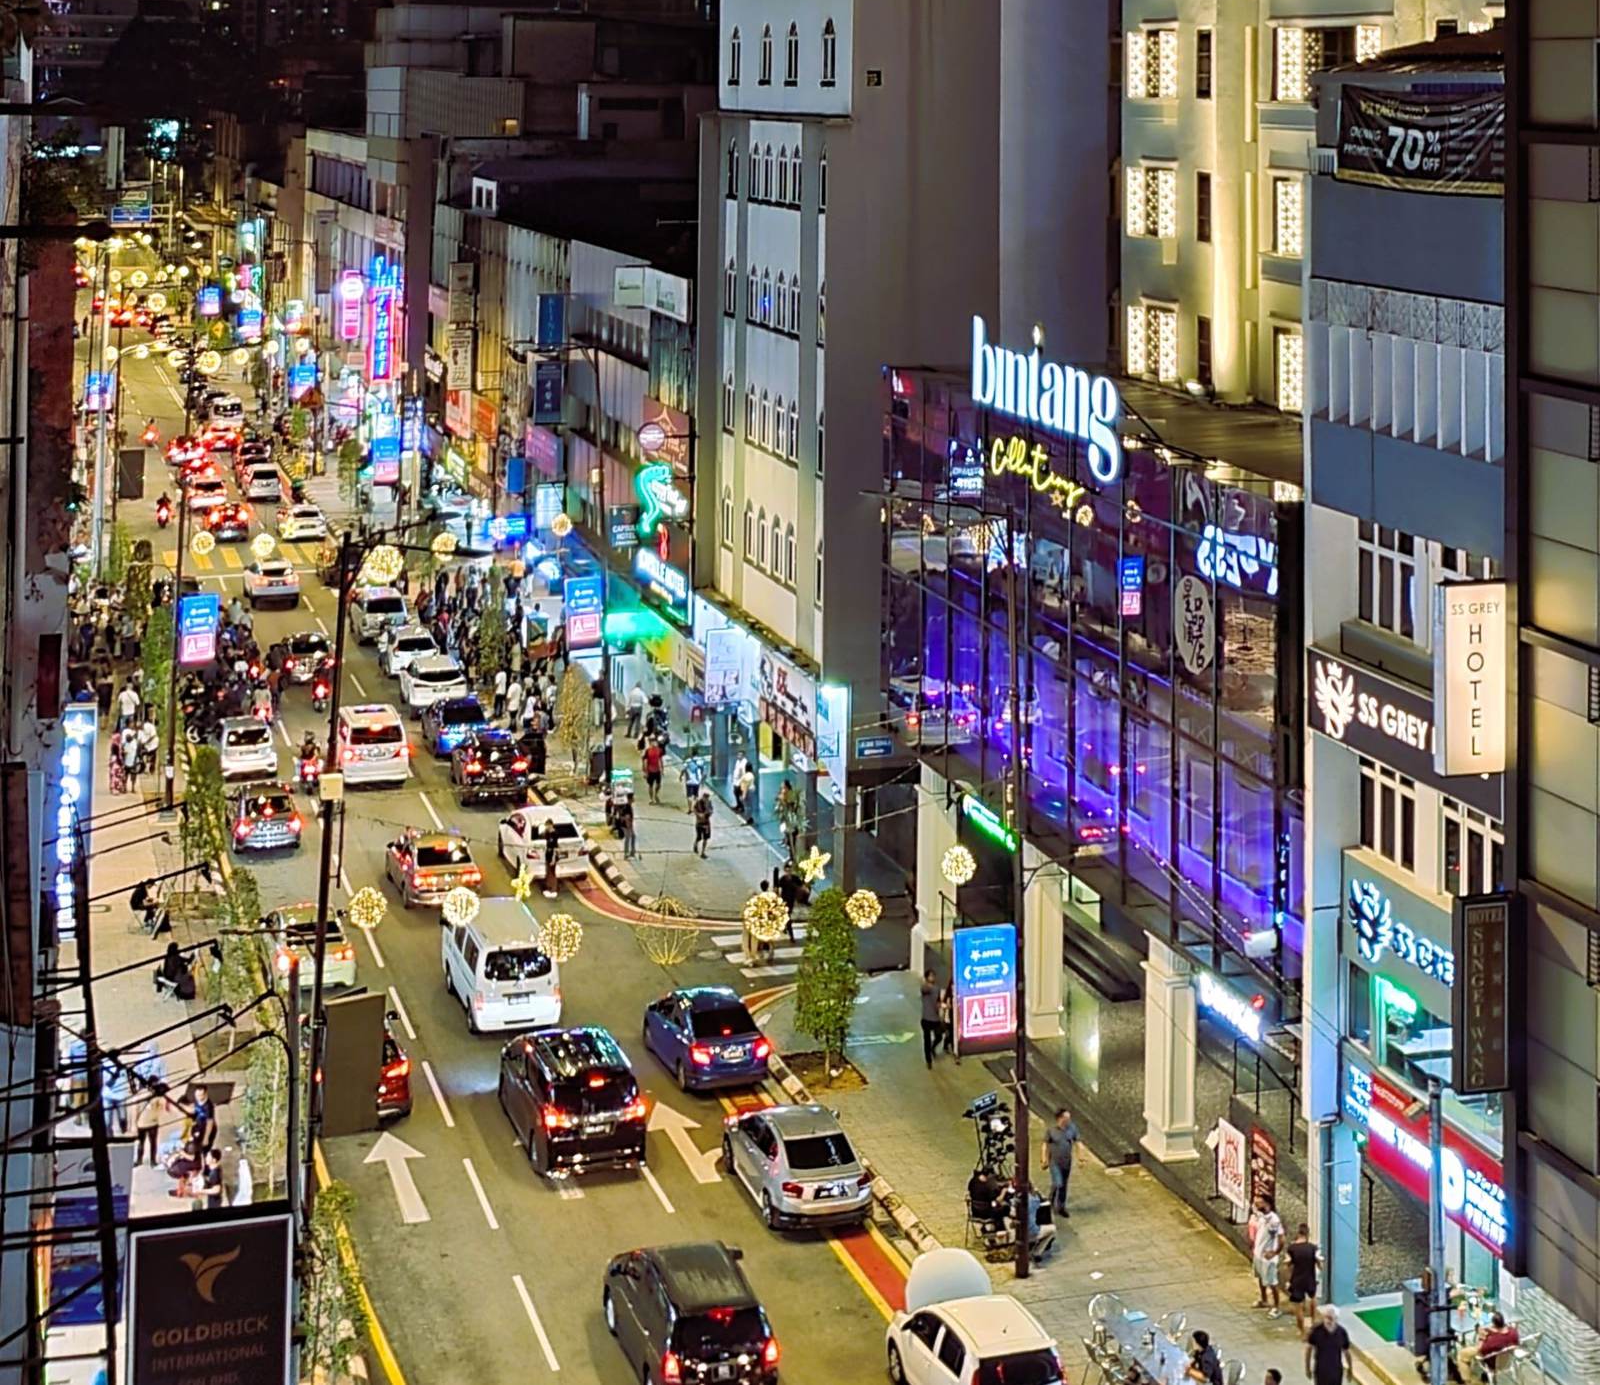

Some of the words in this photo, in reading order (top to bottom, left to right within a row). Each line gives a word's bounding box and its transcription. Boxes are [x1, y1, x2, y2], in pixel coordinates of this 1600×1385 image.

[1423, 156, 1441, 171] OFF
[972, 315, 1120, 482] bintang
[1451, 603, 1466, 615] SS
[1468, 602, 1500, 615] GREY
[1466, 624, 1485, 757] HOTEL
[1358, 694, 1379, 729] SS
[1381, 705, 1428, 751] GREY
[1471, 1027, 1485, 1087] WANG
[152, 1314, 269, 1348] GOLDBRICK
[151, 1343, 265, 1374] INTERNATIONAL
